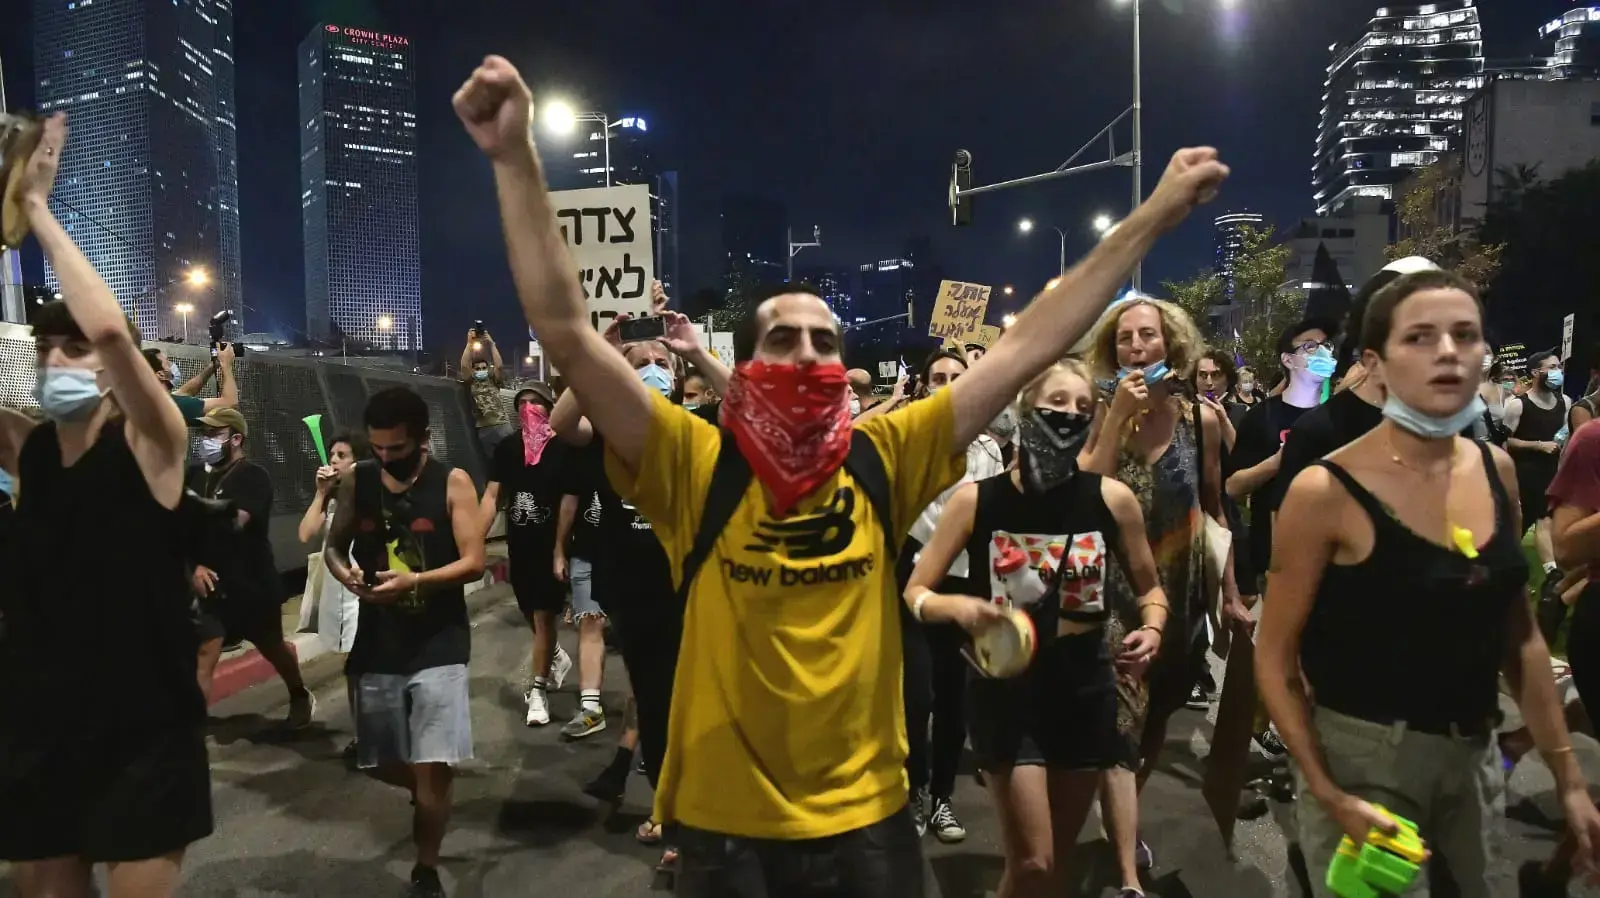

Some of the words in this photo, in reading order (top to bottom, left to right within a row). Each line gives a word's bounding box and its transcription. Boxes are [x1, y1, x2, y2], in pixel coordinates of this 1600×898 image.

[343, 27, 380, 41] CROWNE
[383, 34, 409, 46] PLAZA
[351, 37, 368, 45] CITY
[371, 40, 396, 49] CENTE
[721, 558, 773, 587] new
